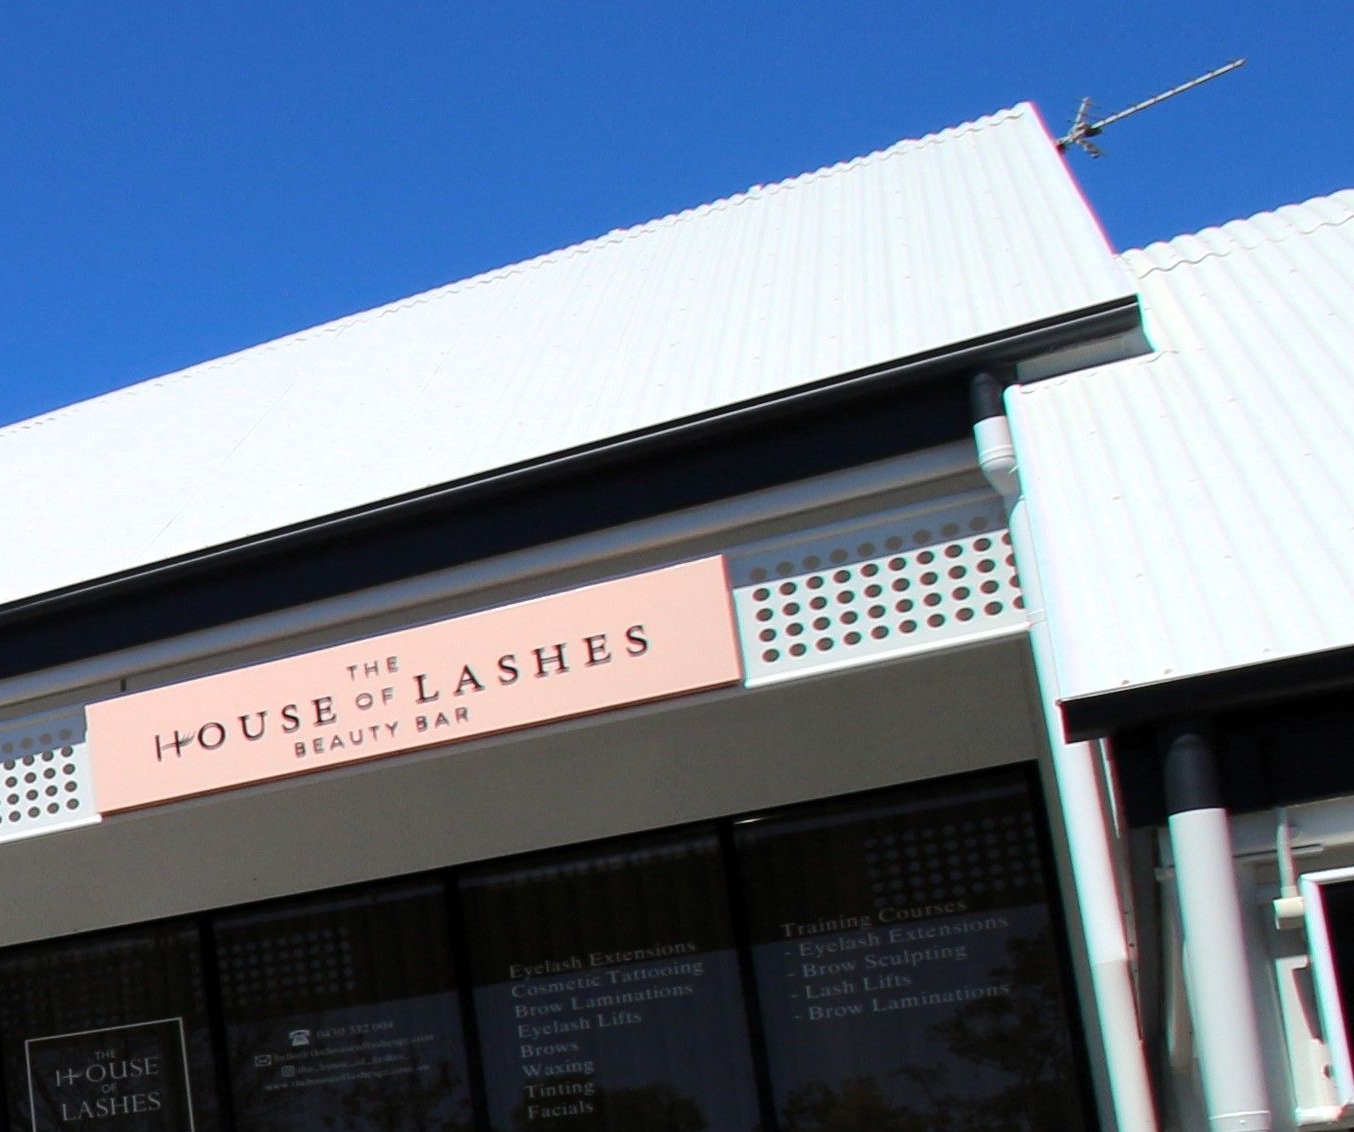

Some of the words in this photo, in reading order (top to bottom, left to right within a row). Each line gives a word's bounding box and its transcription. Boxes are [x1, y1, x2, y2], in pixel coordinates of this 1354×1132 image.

[346, 655, 400, 682] THE
[153, 695, 338, 762] HOUSE
[354, 686, 395, 711] OF
[413, 623, 650, 704] LASHES
[294, 721, 400, 758] BEAUTY
[416, 706, 471, 734] BAR
[779, 914, 873, 938] Training
[878, 899, 968, 923] Courses
[799, 932, 881, 958] Eyelash
[889, 914, 1009, 944] Extensions
[509, 956, 582, 980] Eyelash
[589, 941, 697, 967] Extensions
[802, 961, 856, 979] Brow
[864, 944, 968, 969] Sculpting
[511, 974, 602, 998] Cosmetic
[604, 960, 705, 985] Tattooing
[805, 978, 855, 1000] Lash
[863, 972, 912, 993] Lifts
[514, 1002, 564, 1019] Brow
[570, 983, 694, 1011] Laminations
[808, 1002, 864, 1021] Brow
[872, 981, 1011, 1013] Laminations
[517, 1016, 591, 1040] Eyelash
[597, 1010, 643, 1029] Lifts
[95, 1050, 116, 1060] THE
[519, 1040, 580, 1059] Brows
[55, 1056, 160, 1087] HOUSE
[522, 1059, 595, 1078] Waxing
[100, 1083, 118, 1094] OF
[524, 1080, 595, 1099] Tinting
[61, 1091, 162, 1121] LASHES
[526, 1099, 594, 1121] Facials
